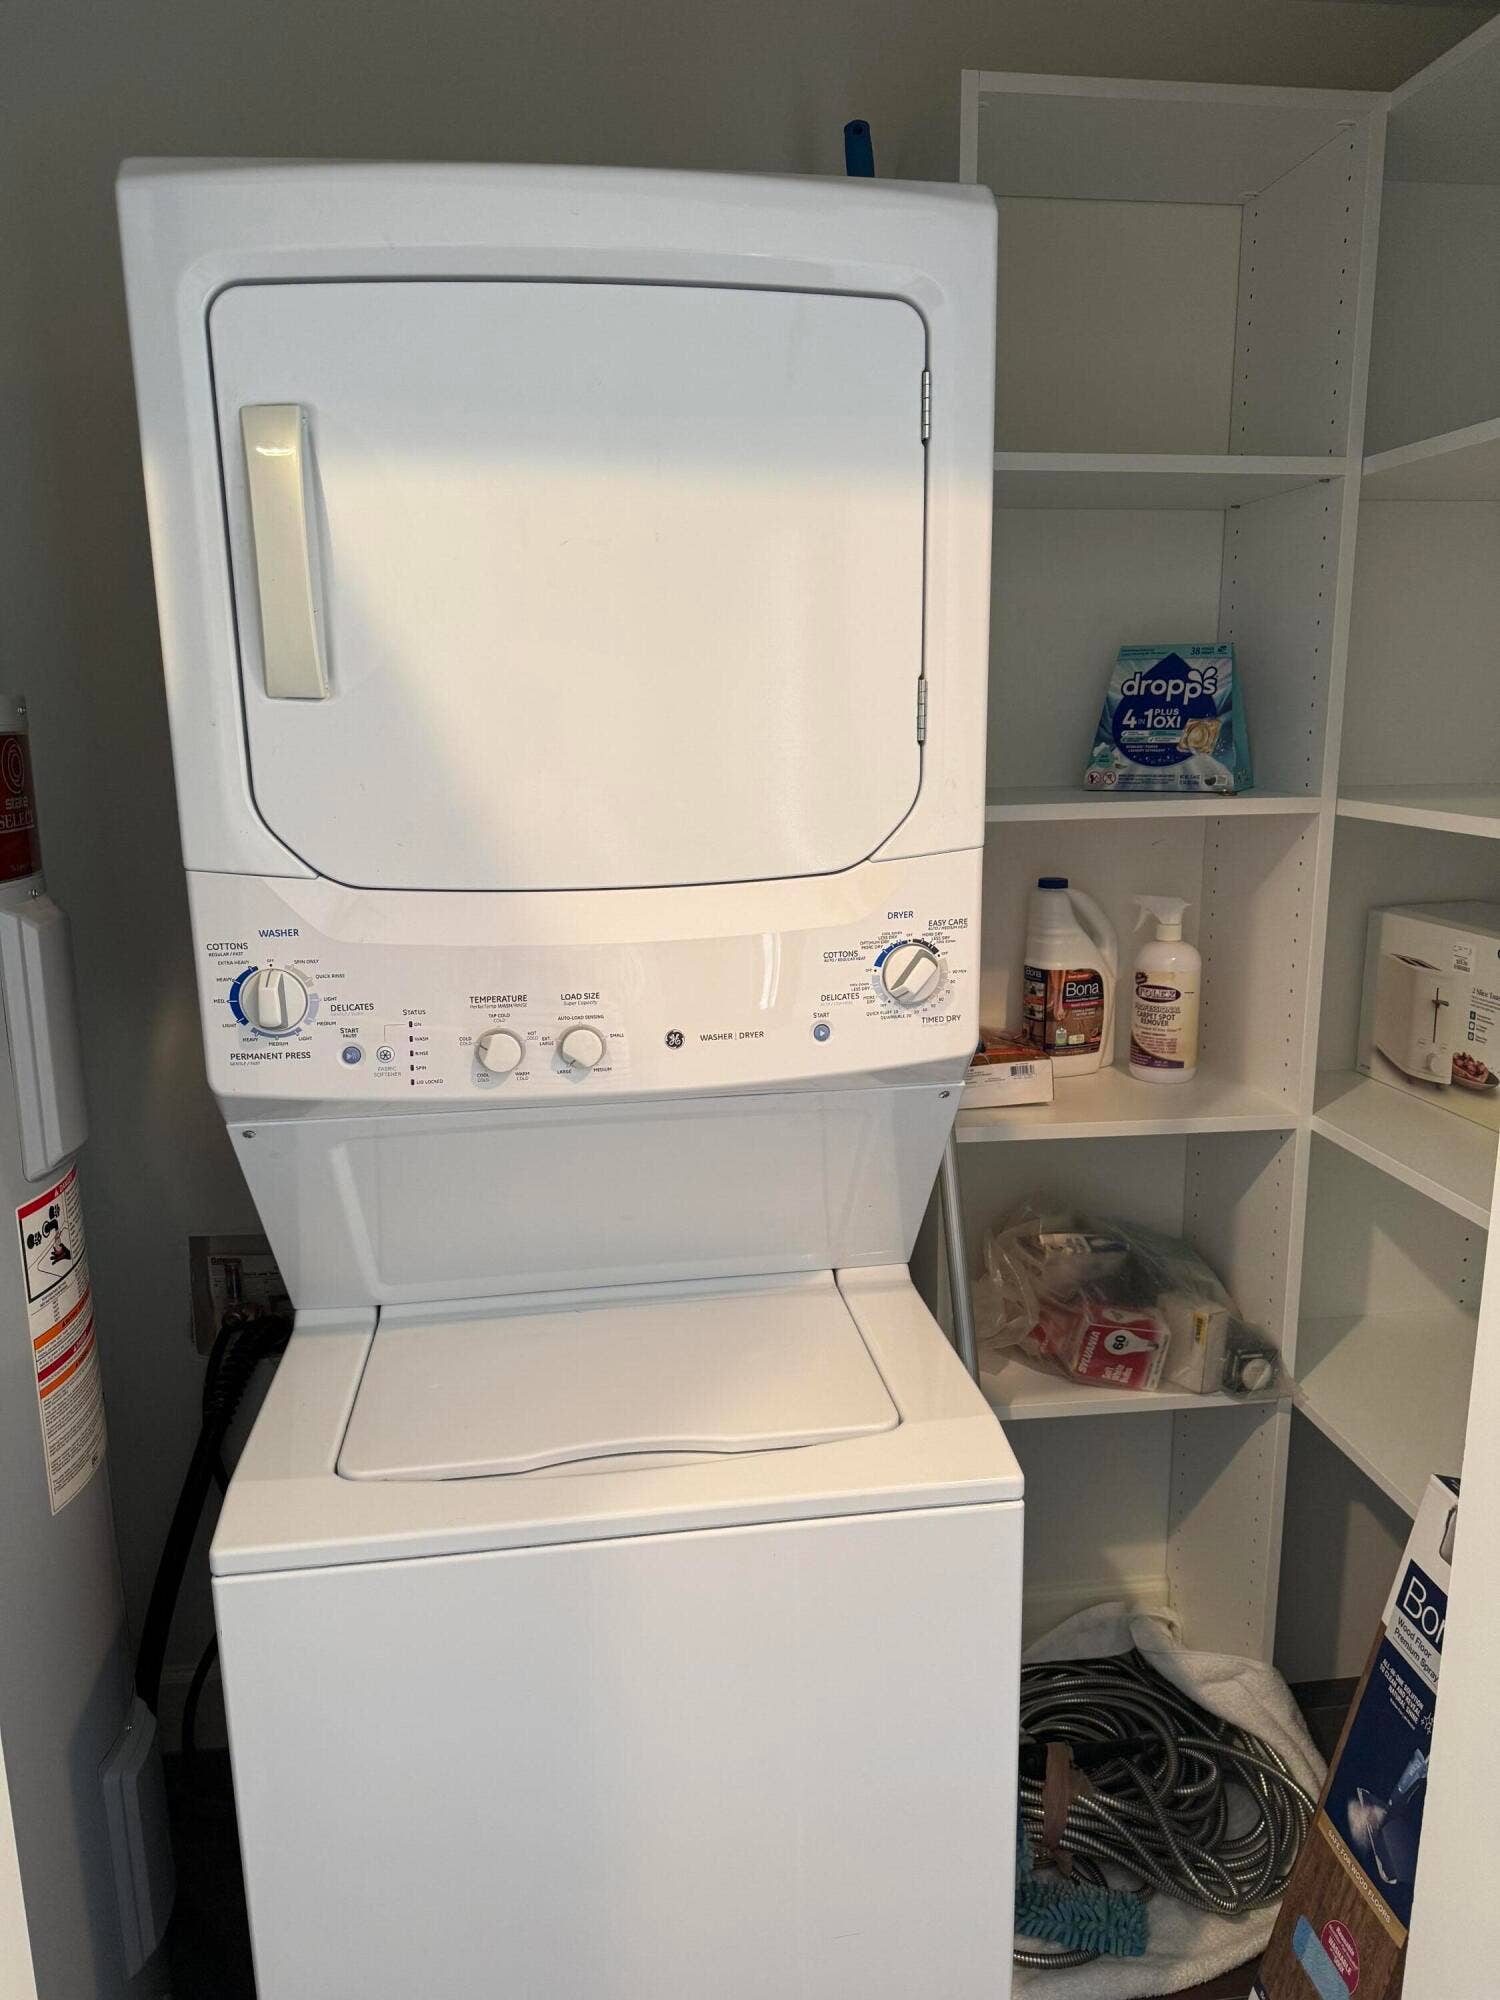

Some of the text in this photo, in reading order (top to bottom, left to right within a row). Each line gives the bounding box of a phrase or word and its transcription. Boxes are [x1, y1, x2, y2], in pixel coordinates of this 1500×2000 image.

[1121, 669, 1218, 706] dropps
[1154, 708, 1180, 716] PLUS
[1122, 709, 1138, 729] 4
[1144, 708, 1154, 729] 1
[1154, 716, 1181, 728] OXI
[887, 910, 914, 920] DRYER
[948, 918, 968, 926] CARE
[258, 928, 300, 938] WASHER
[206, 942, 248, 951] COTTONS
[823, 950, 858, 959] COTTONS
[1066, 982, 1099, 997] Bona
[470, 994, 528, 1004] TEMPERATURE
[560, 992, 600, 1001] LOAD SIZE
[820, 993, 860, 1002] DELICATES
[330, 1003, 374, 1012] DELICATES
[921, 1014, 962, 1024] TIMED DRY
[700, 1033, 733, 1042] WASHER
[739, 1031, 765, 1040] DRYER
[230, 1051, 311, 1061] PERMANENT PRESS
[1112, 1334, 1127, 1350] 60
[1078, 1330, 1101, 1374] SYLVANIA
[1398, 1615, 1432, 1659] Wood Floor
[1394, 1627, 1440, 1683] Premium Spray
[1328, 1829, 1391, 1924] SAFE FOR WOOD FLOORS
